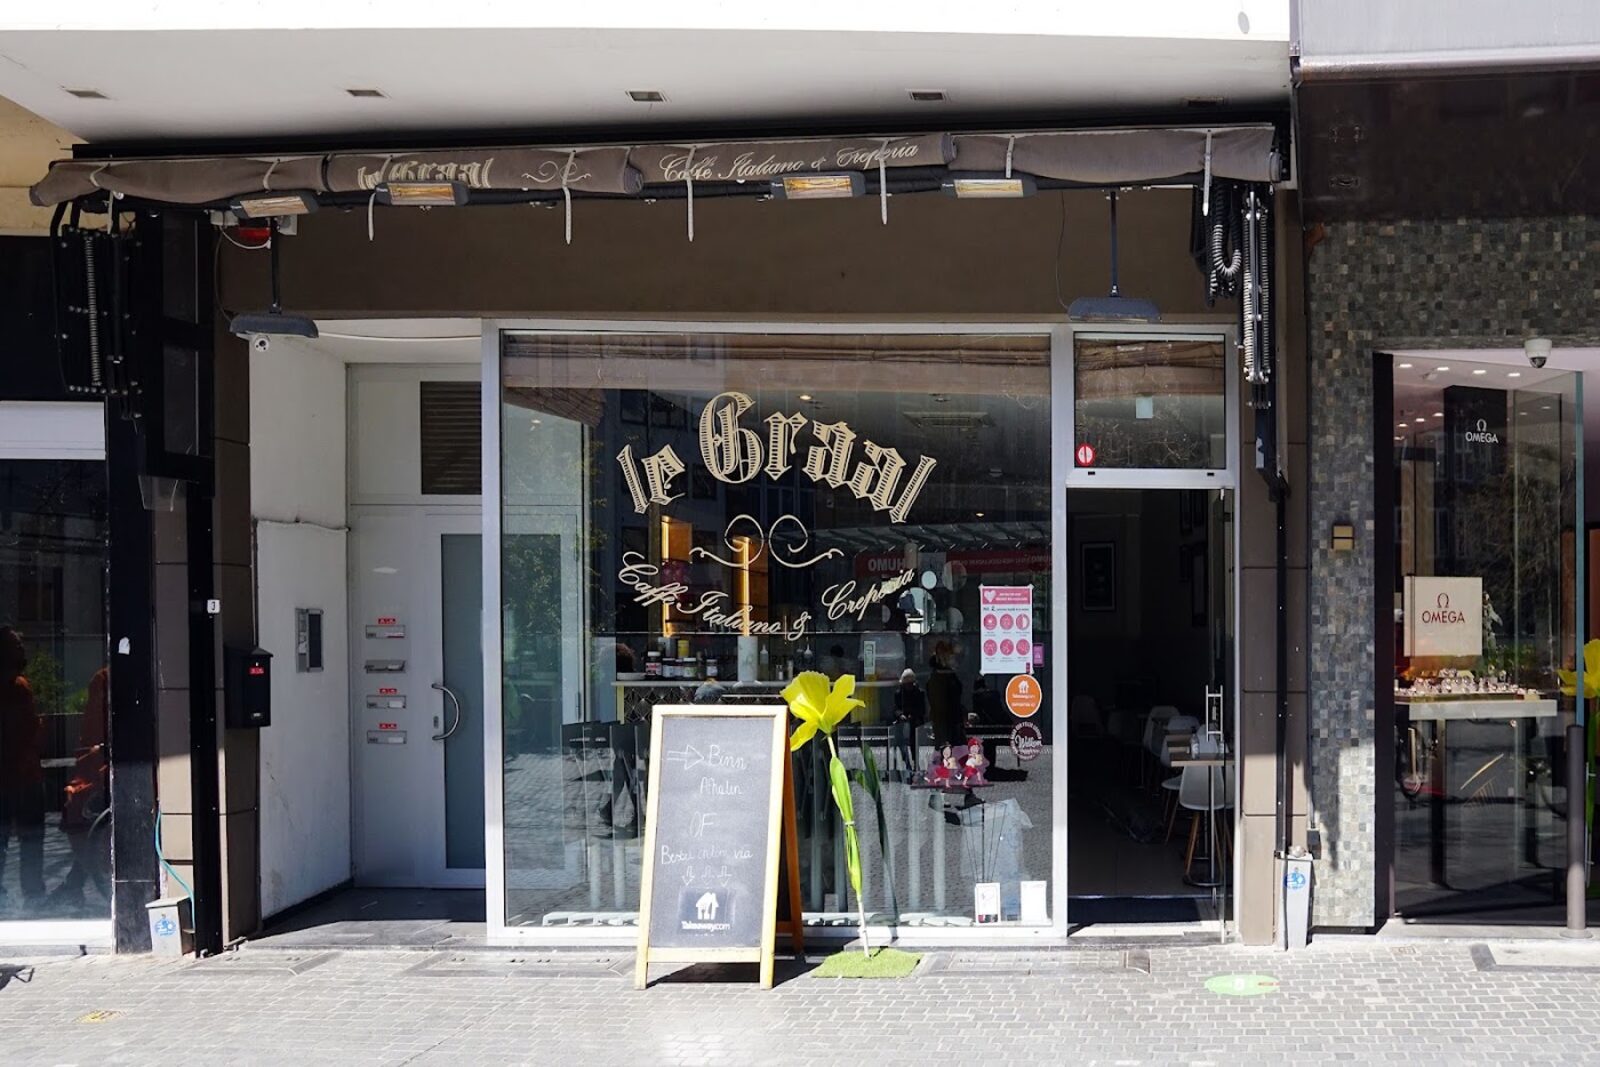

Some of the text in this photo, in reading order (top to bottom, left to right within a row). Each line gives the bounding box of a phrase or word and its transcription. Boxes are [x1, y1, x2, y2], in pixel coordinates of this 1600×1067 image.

[718, 152, 805, 179] Italiano
[1465, 431, 1499, 444] OMEGA
[616, 391, 937, 523] le Graal
[787, 612, 812, 641] &
[821, 568, 915, 621] Crepia
[1421, 611, 1465, 624] OMEGA
